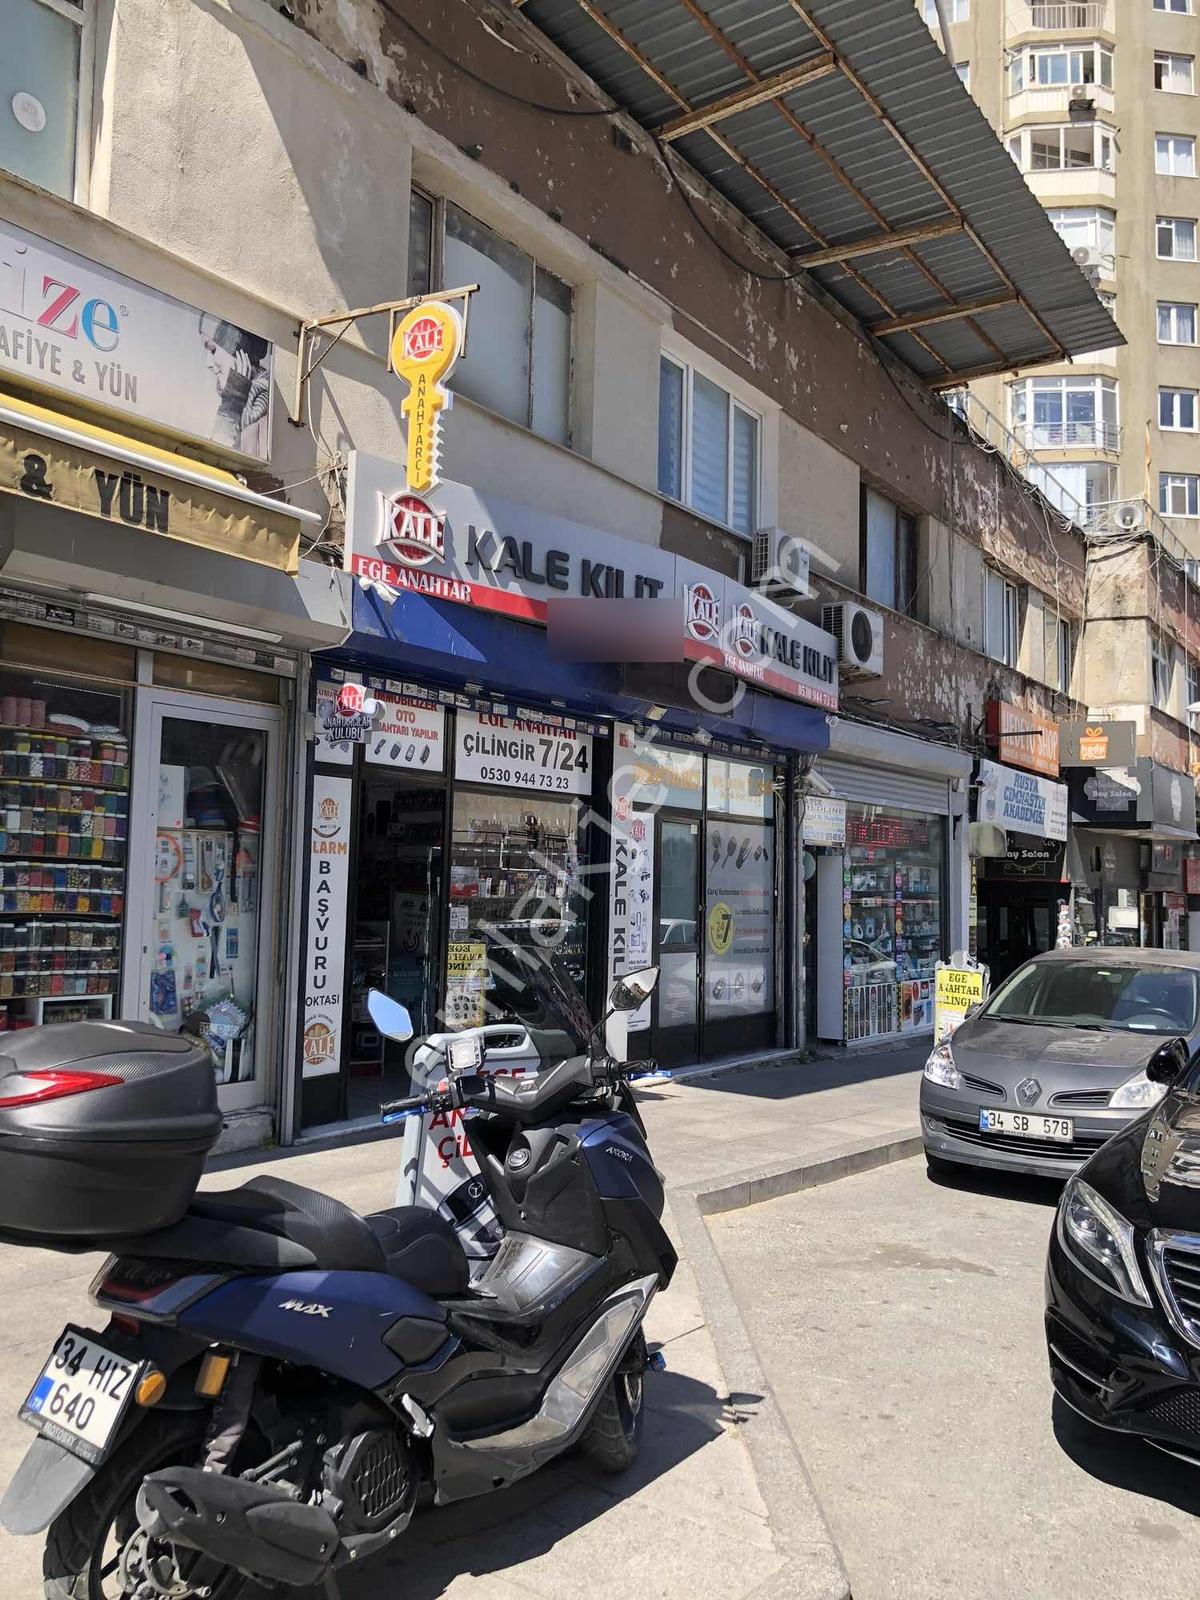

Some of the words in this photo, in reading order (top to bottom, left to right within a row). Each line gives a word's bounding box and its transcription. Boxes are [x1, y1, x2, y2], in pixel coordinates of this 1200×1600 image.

[402, 322, 444, 360] KALE
[71, 358, 87, 385] &
[95, 361, 137, 404] YÜN
[413, 372, 427, 484] ANAHTARCI
[20, 454, 53, 498] &
[94, 468, 170, 534] YÜN
[380, 497, 448, 556] KALE
[465, 524, 570, 591] KALE
[357, 558, 391, 584] EGE
[396, 570, 472, 602] ANAHTAR
[687, 590, 721, 629] KALE
[760, 624, 801, 670] KALE
[395, 709, 416, 724] OTO
[411, 729, 439, 741] YAPILIR
[463, 731, 536, 762] ÇİLİNGİR
[538, 738, 589, 774] 7/24
[480, 766, 511, 782] 0530
[514, 770, 536, 786] 944
[539, 773, 553, 788] 73
[556, 775, 570, 790] 23
[1013, 773, 1039, 794] RUSYA
[1006, 851, 1020, 860] ay
[1021, 849, 1050, 859] Salon
[613, 838, 628, 917] KALE
[313, 860, 332, 990] BAŞVURU
[948, 973, 968, 984] EGE
[304, 1037, 336, 1059] ALE
[989, 1112, 1004, 1128] 34
[1013, 1116, 1030, 1131] SB
[1043, 1121, 1070, 1137] 578
[54, 1337, 89, 1377] 34
[88, 1355, 133, 1401] HIZ
[49, 1382, 96, 1431] 640
